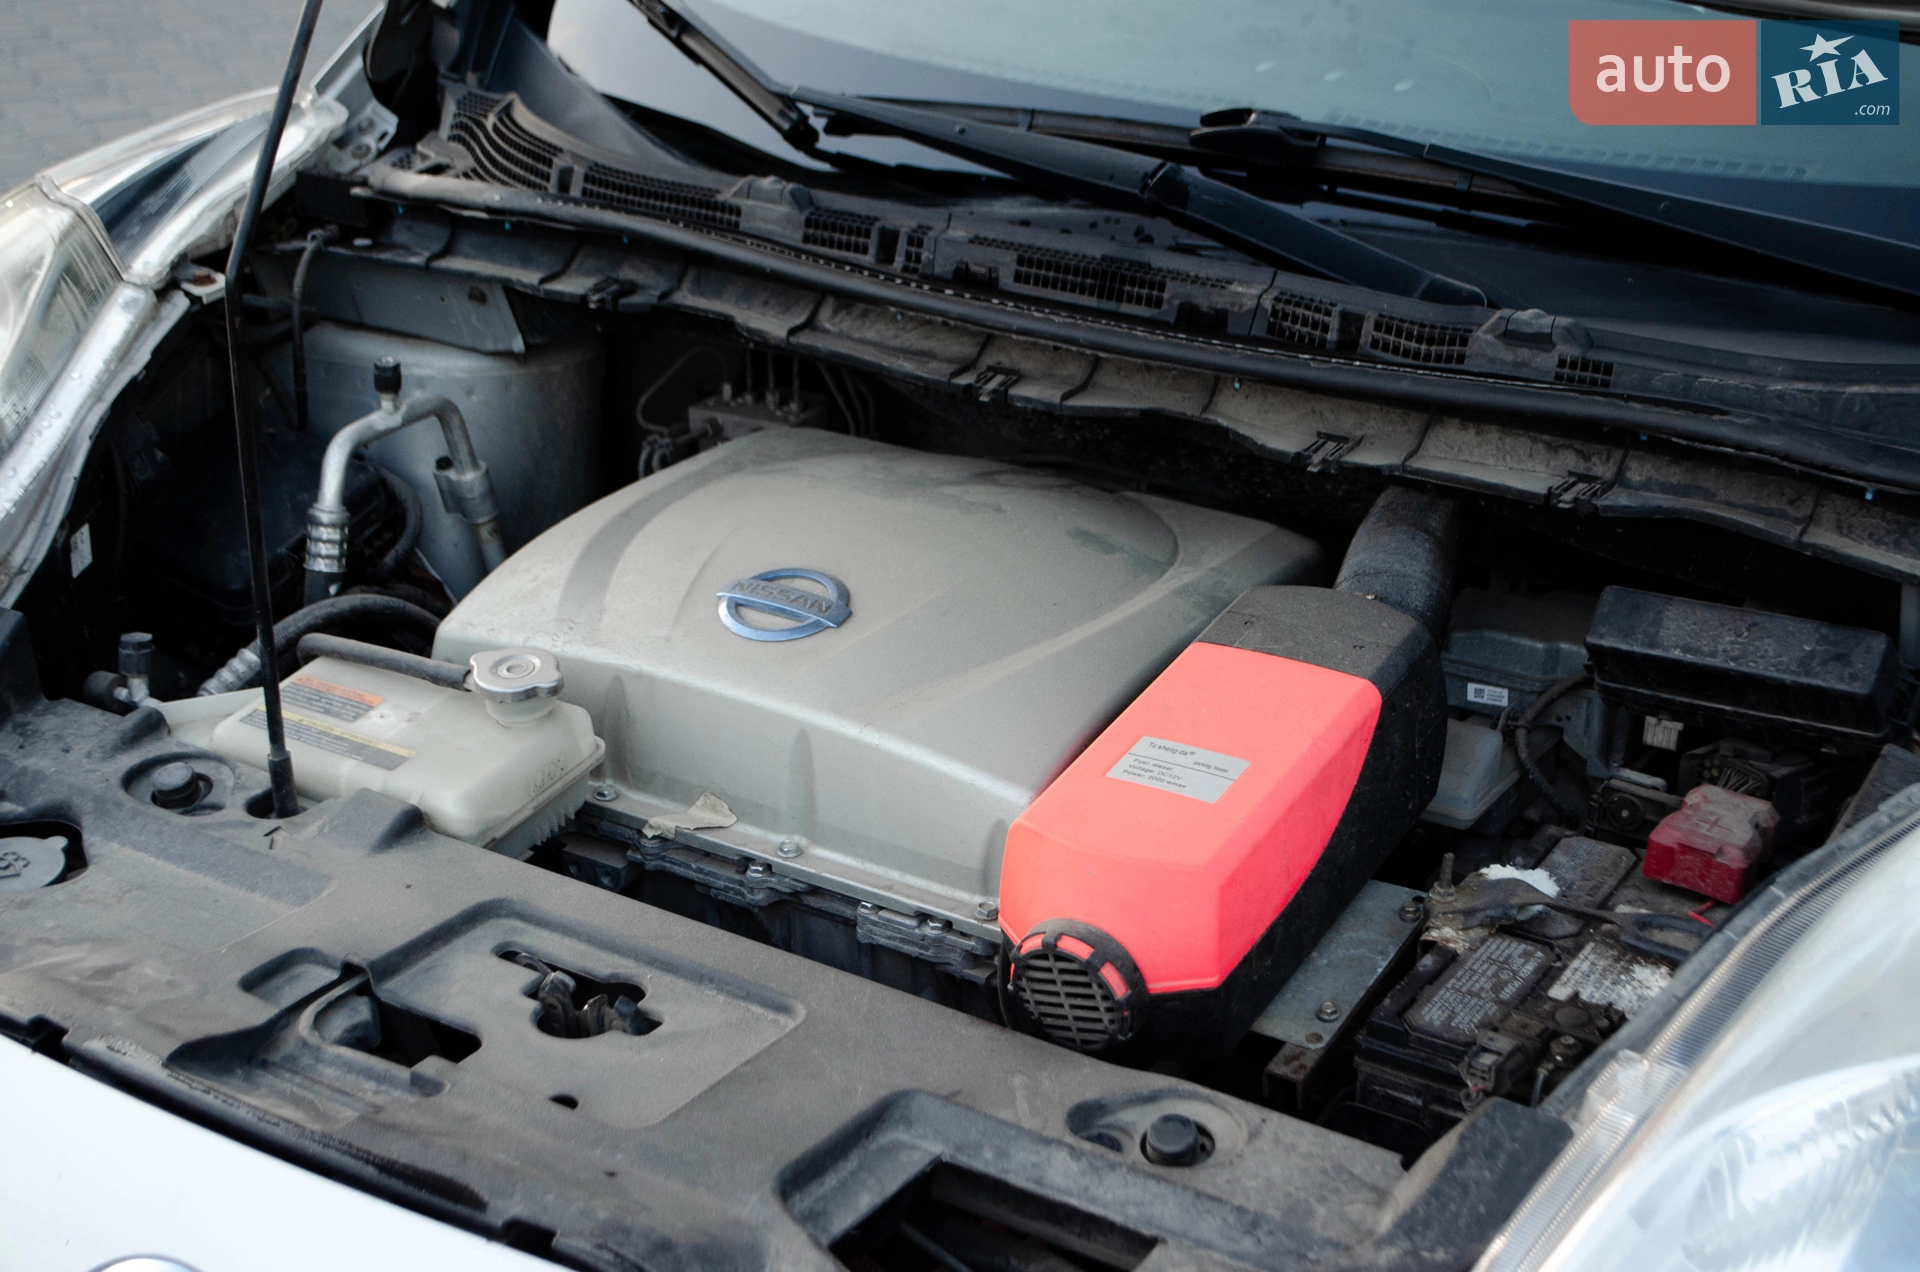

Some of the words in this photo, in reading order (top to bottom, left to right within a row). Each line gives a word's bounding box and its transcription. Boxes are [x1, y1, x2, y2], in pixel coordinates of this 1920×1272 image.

[729, 581, 835, 616] NISSAN
[1148, 742, 1157, 750] Tu
[1158, 744, 1178, 755] sheng
[1151, 762, 1173, 772] diesel
[1147, 775, 1166, 784] 2000
